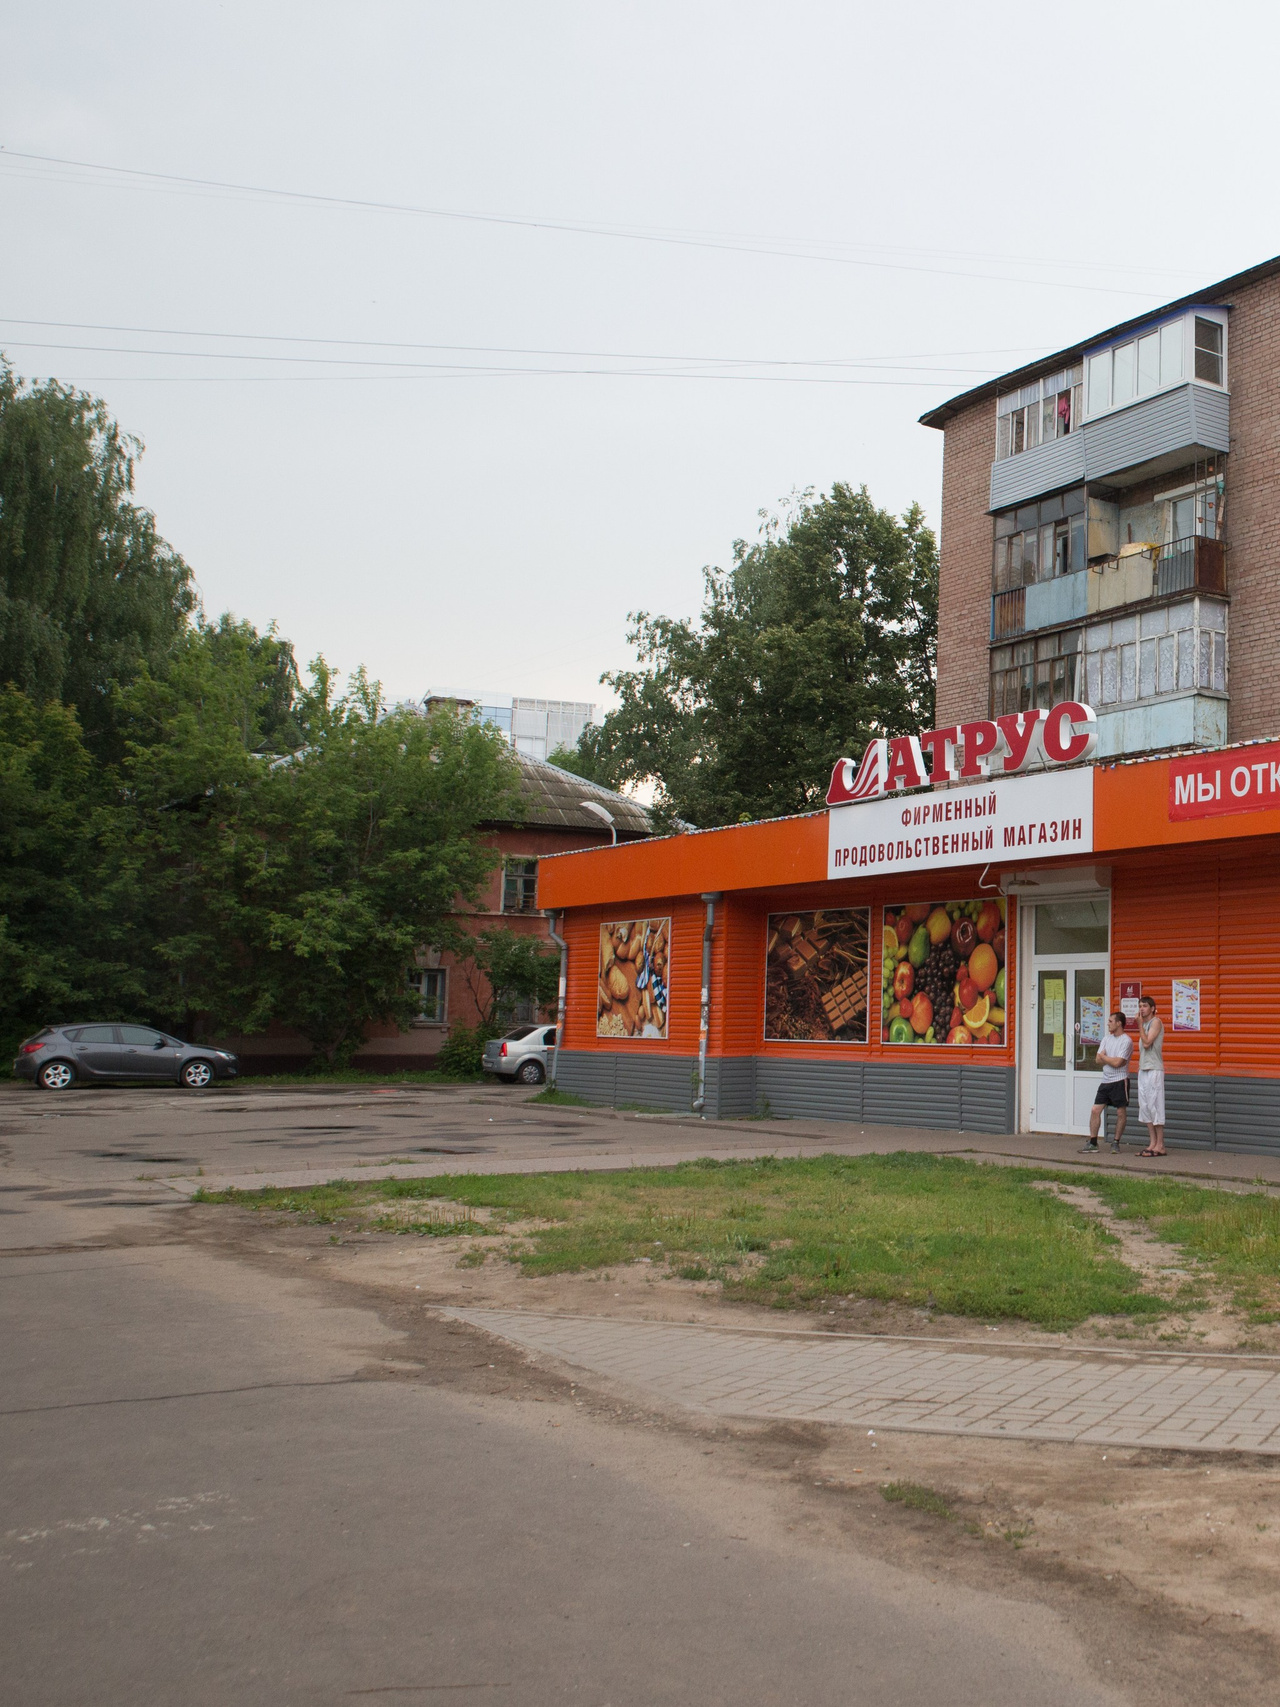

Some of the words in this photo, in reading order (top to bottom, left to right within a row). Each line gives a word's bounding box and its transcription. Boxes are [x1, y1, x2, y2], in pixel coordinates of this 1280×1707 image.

[884, 701, 1096, 791] АТРУС
[901, 790, 997, 827] ФИРМЕННЫЙ
[1174, 770, 1221, 805] МЫ
[834, 825, 994, 867] ПРОДОВОЛЬСТВЕННЫЙ
[1003, 818, 1082, 848] МАГАЗИН
